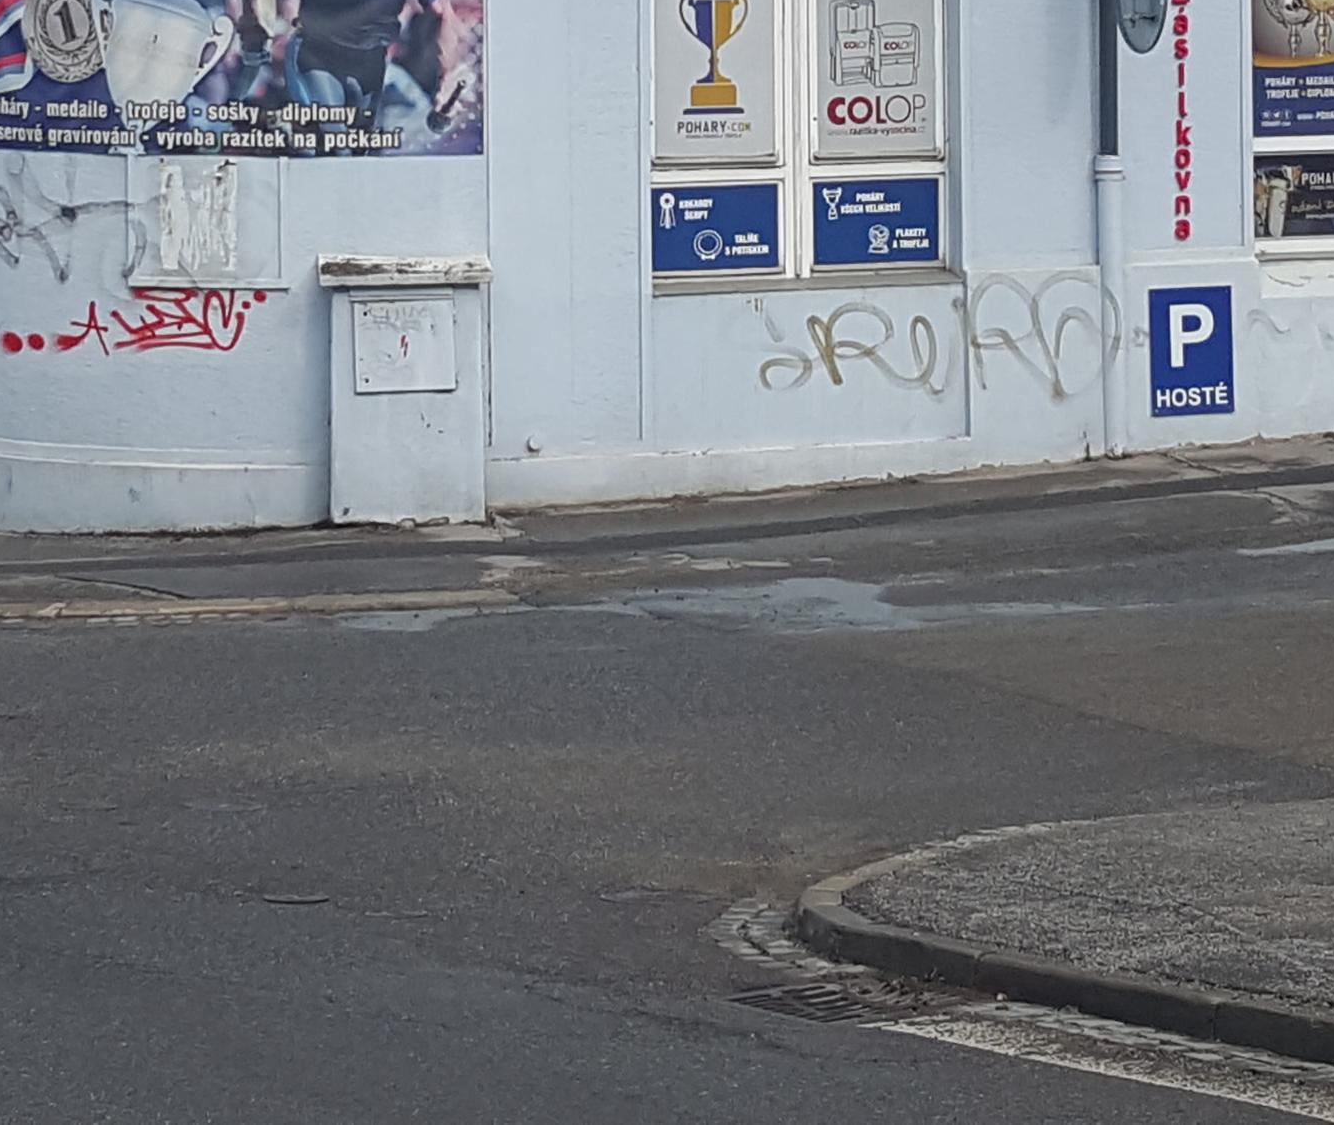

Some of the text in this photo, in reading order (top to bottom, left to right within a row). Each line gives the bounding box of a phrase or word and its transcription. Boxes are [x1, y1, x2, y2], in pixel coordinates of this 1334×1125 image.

[47, 98, 108, 119] medaile
[128, 99, 186, 123] trofeje
[208, 99, 260, 126] sošky
[283, 103, 357, 126] diplomy
[826, 94, 926, 126] COLOP
[48, 123, 137, 150] gravírování
[157, 126, 215, 151] výroba
[222, 126, 287, 148] razítek
[294, 132, 318, 148] na
[324, 125, 404, 154] počkání
[1169, 303, 1214, 368] P
[1156, 381, 1229, 409] HOSTÉ
